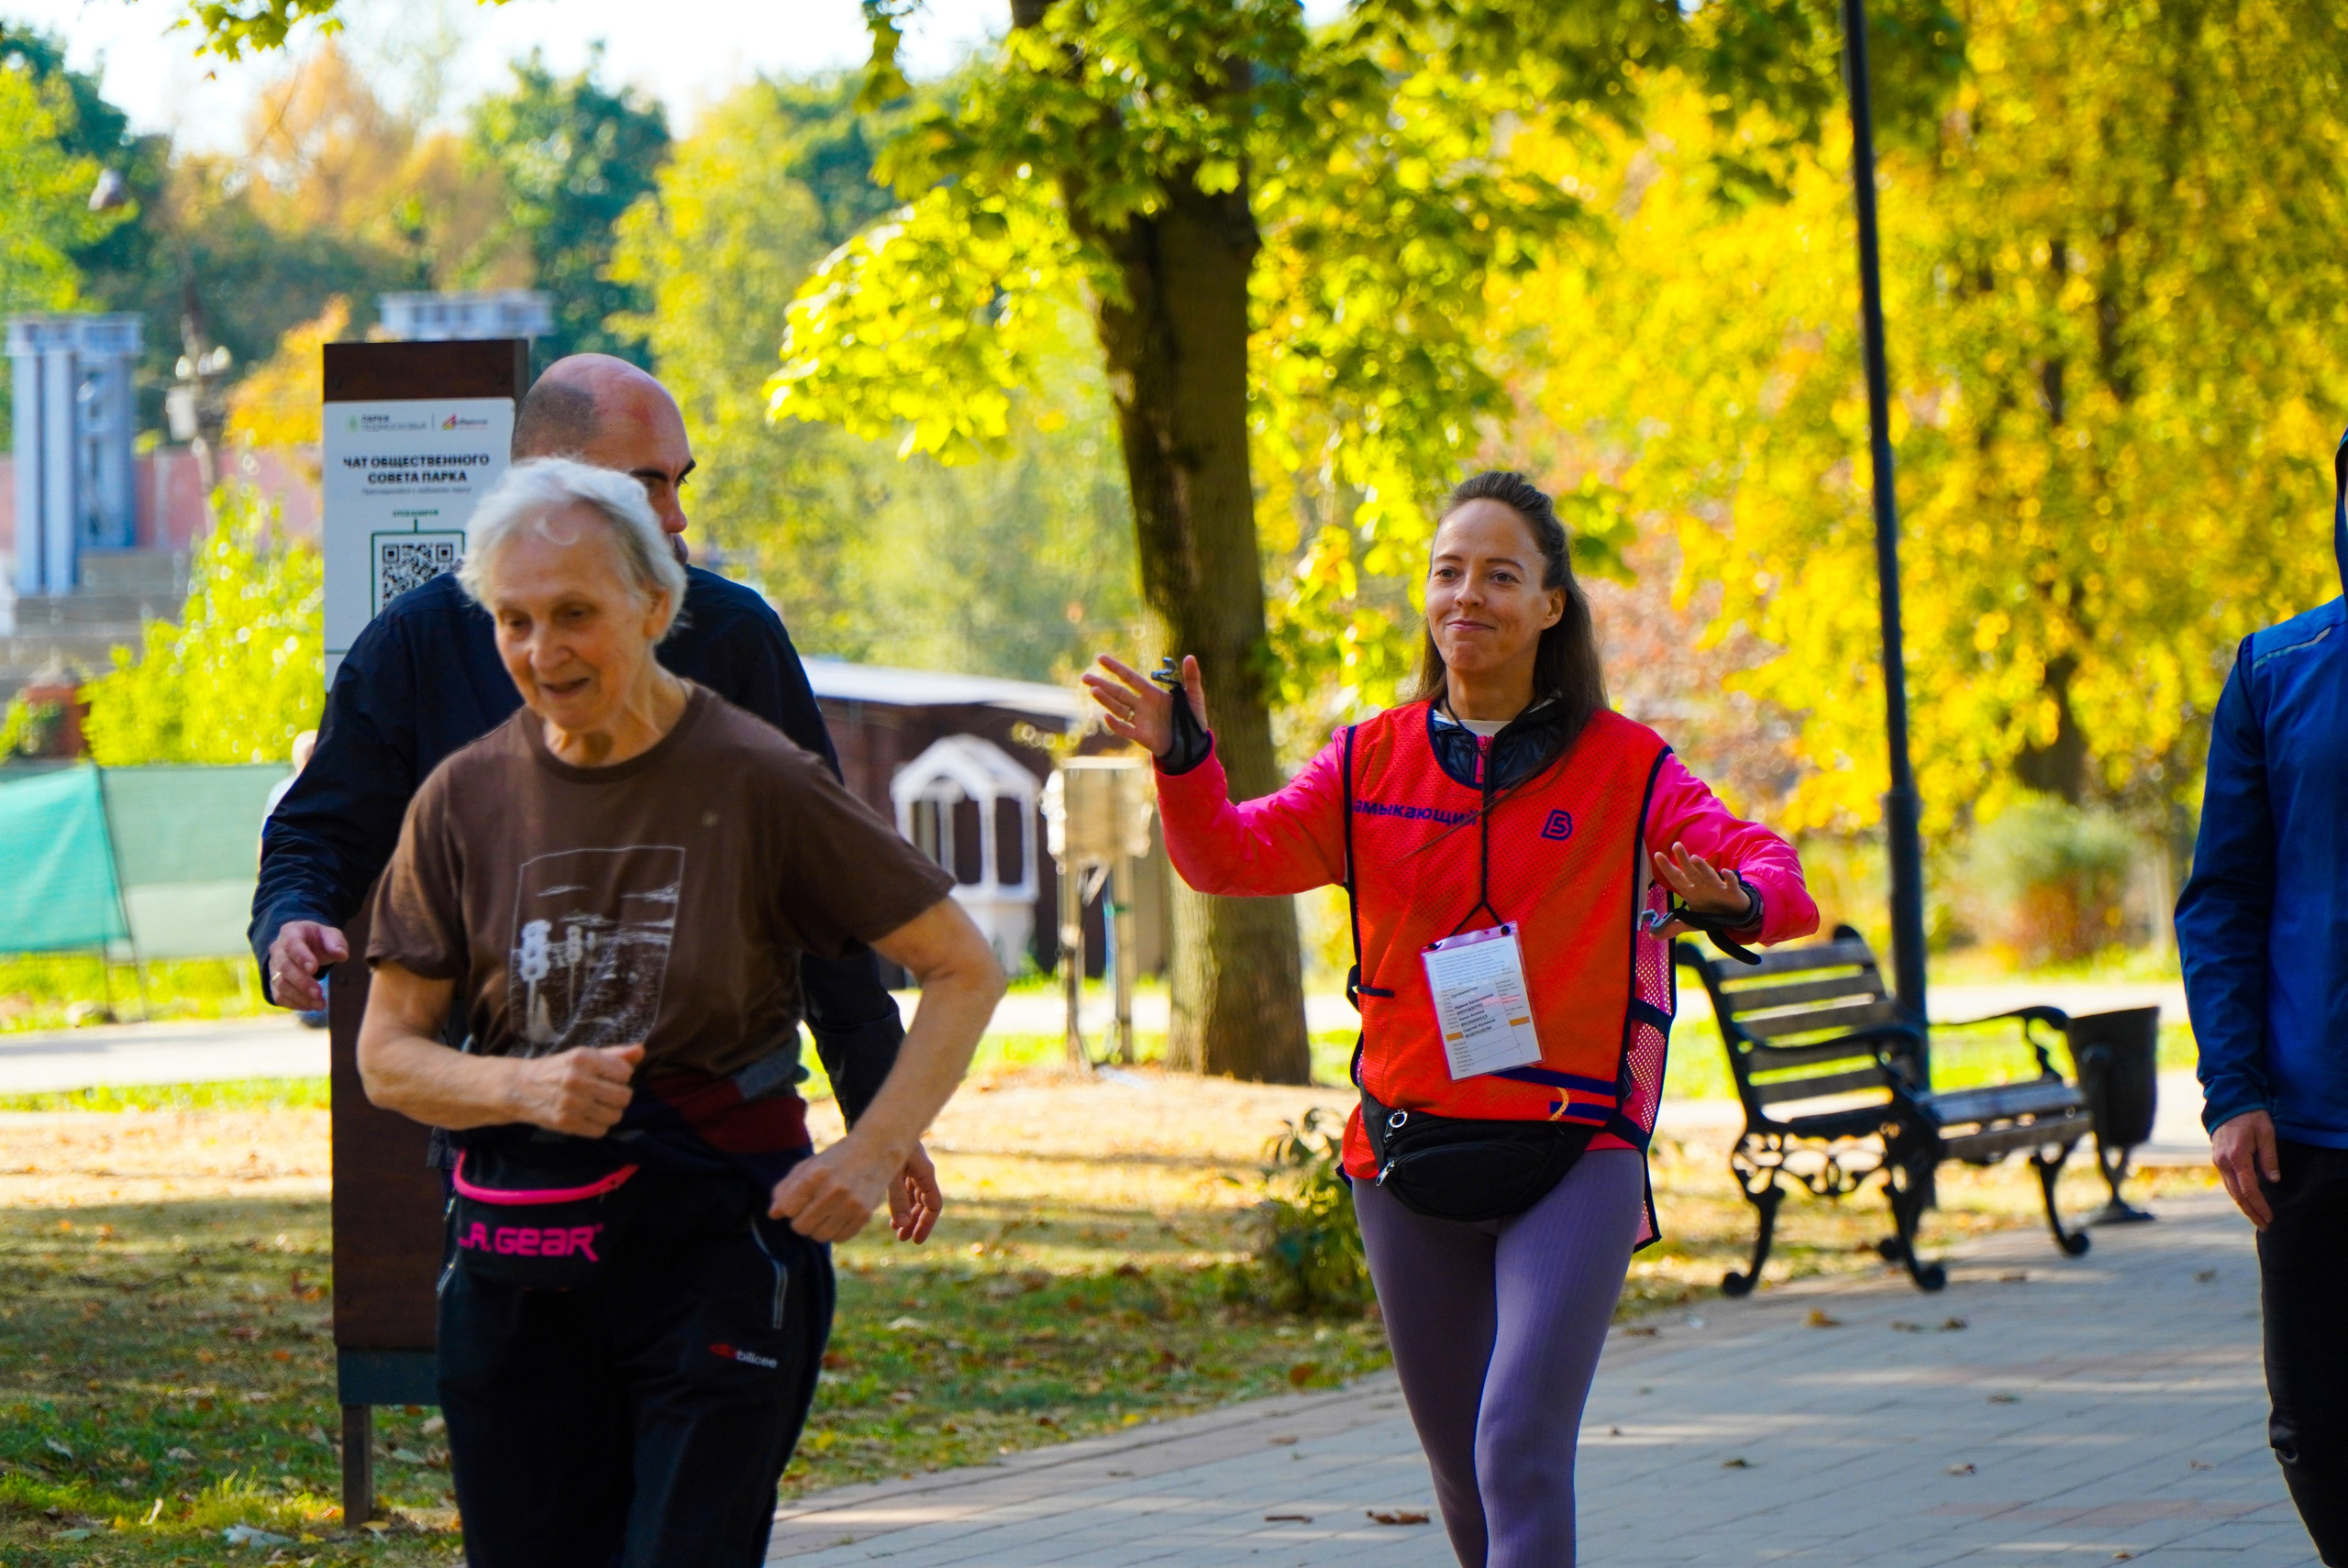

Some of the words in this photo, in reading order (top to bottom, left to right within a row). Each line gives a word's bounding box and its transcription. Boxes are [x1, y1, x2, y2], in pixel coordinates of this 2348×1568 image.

[343, 456, 368, 469] ЧАТ
[371, 454, 490, 469] ОБЩЕСТВЕННОГО
[368, 470, 419, 484] СОВЕТА
[422, 469, 468, 483] ПАРКА
[1353, 800, 1478, 826] амыкающий
